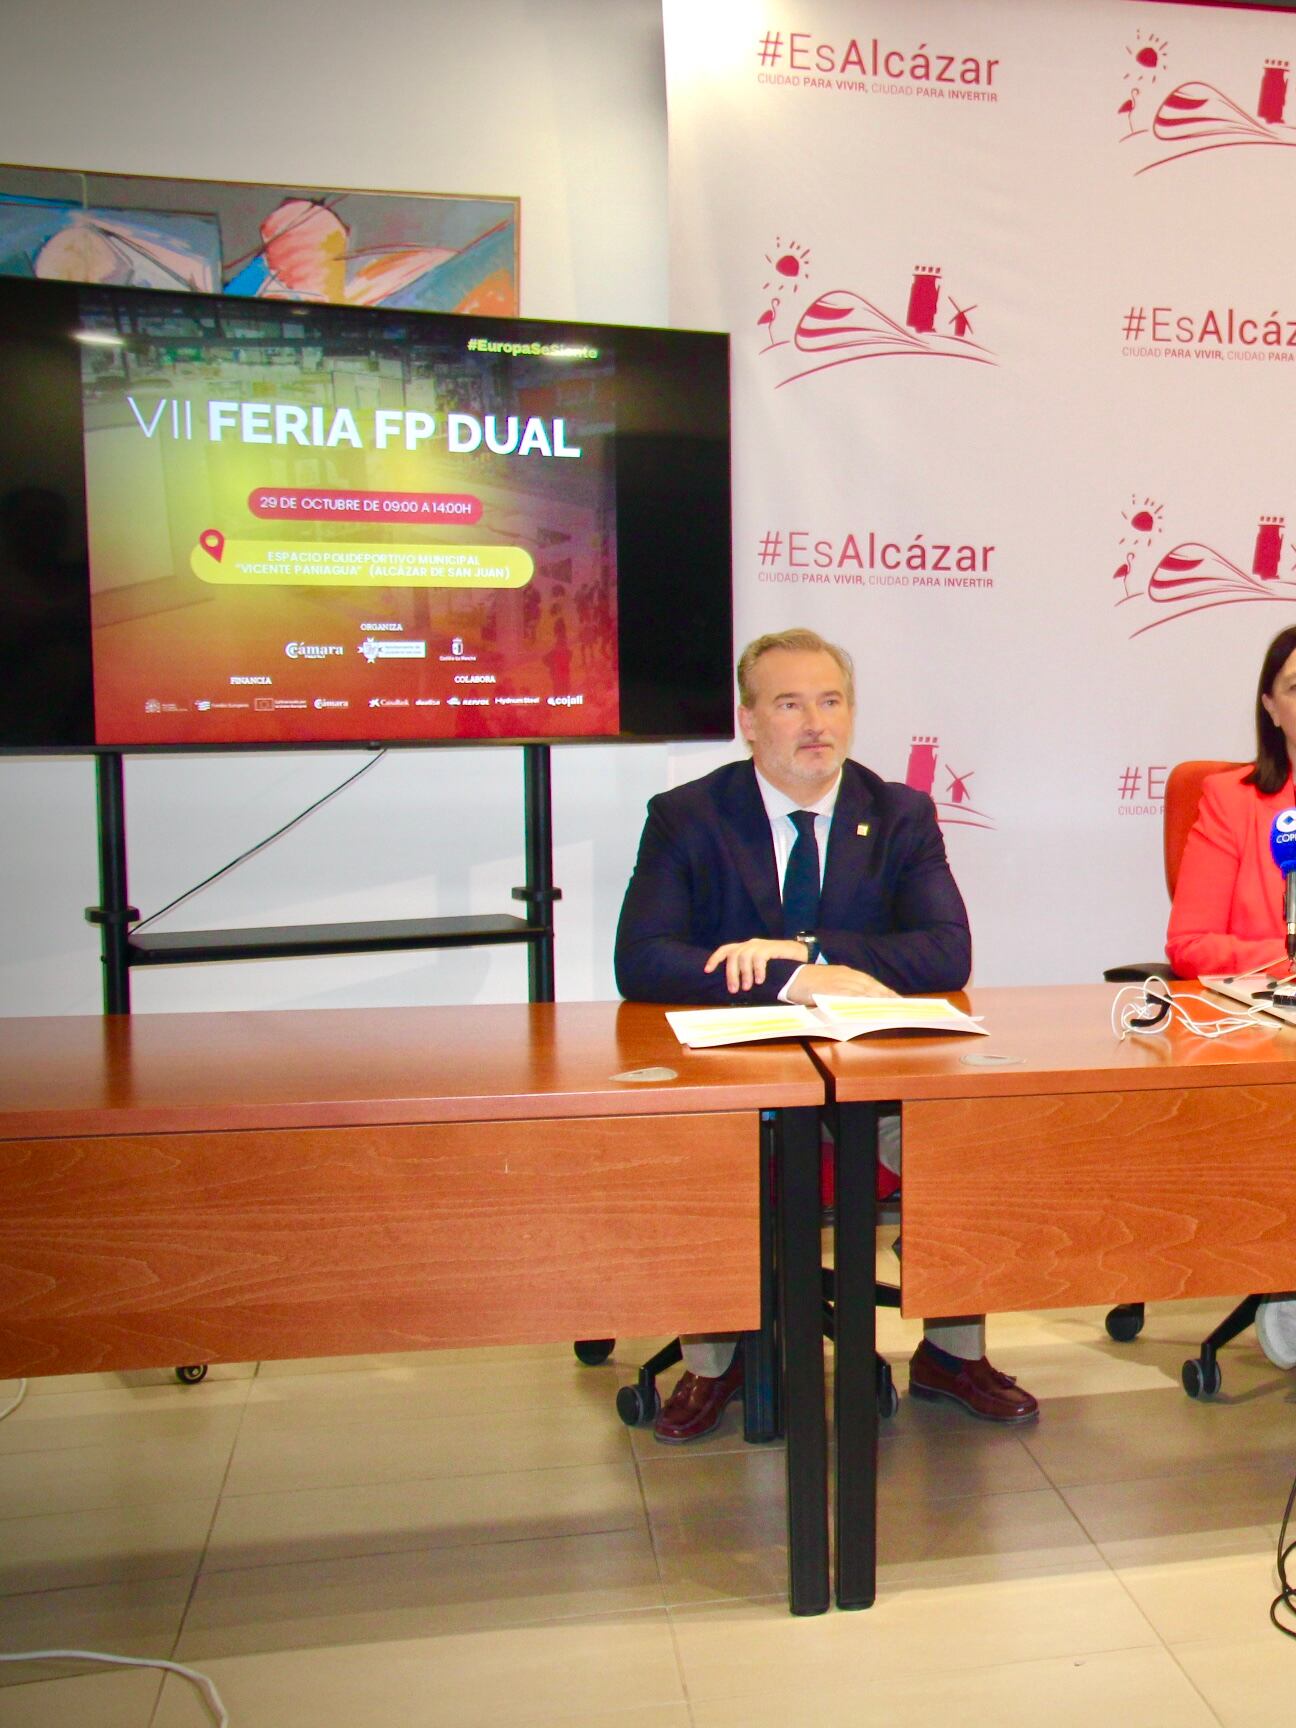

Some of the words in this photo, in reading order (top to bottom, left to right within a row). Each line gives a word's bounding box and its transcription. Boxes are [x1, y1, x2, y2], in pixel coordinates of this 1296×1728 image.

[757, 31, 999, 86] #EsAlcázar
[757, 73, 800, 86] CIUDAD
[803, 77, 832, 89] PARA
[836, 80, 868, 93] VIVIR,
[871, 83, 913, 96] CIUDAD
[916, 87, 945, 99] PARA
[948, 90, 998, 102] INVERTIR
[467, 338, 599, 359] #EuropaSeSinte
[1122, 346, 1161, 358] CIUDAD
[1164, 348, 1191, 358] PARA
[1194, 350, 1224, 361] VIVIR,
[1227, 351, 1265, 361] CIUDAD
[1268, 352, 1294, 362] PARA
[127, 396, 193, 441] VII
[208, 400, 363, 449] FERIA
[375, 409, 437, 451] FP
[447, 413, 581, 458] DUAL
[259, 496, 278, 510] 29
[280, 497, 298, 510] DE
[301, 498, 361, 512] OCTUBRE
[363, 500, 380, 513] DE
[383, 501, 419, 513] 09:00
[421, 502, 431, 513] A
[432, 502, 472, 515] 14:00H
[267, 551, 321, 563] ESPACIO
[418, 553, 480, 565] MUNICIPAL
[758, 531, 995, 572] #EsAlcázar
[431, 566, 446, 577] DE
[447, 566, 472, 578] SAN
[473, 566, 511, 580] JUAN)
[758, 572, 799, 583] CIUDAD
[802, 574, 830, 584] PARA
[833, 575, 866, 586] VIVIR,
[868, 576, 909, 586] CIUDAD
[912, 577, 940, 587] PARA
[944, 578, 993, 588] INVERTIR
[360, 623, 403, 631] ORGANIZA
[230, 676, 272, 685] FINANCIA
[454, 675, 496, 684] COLABORA
[1118, 805, 1157, 816] CIUDAD
